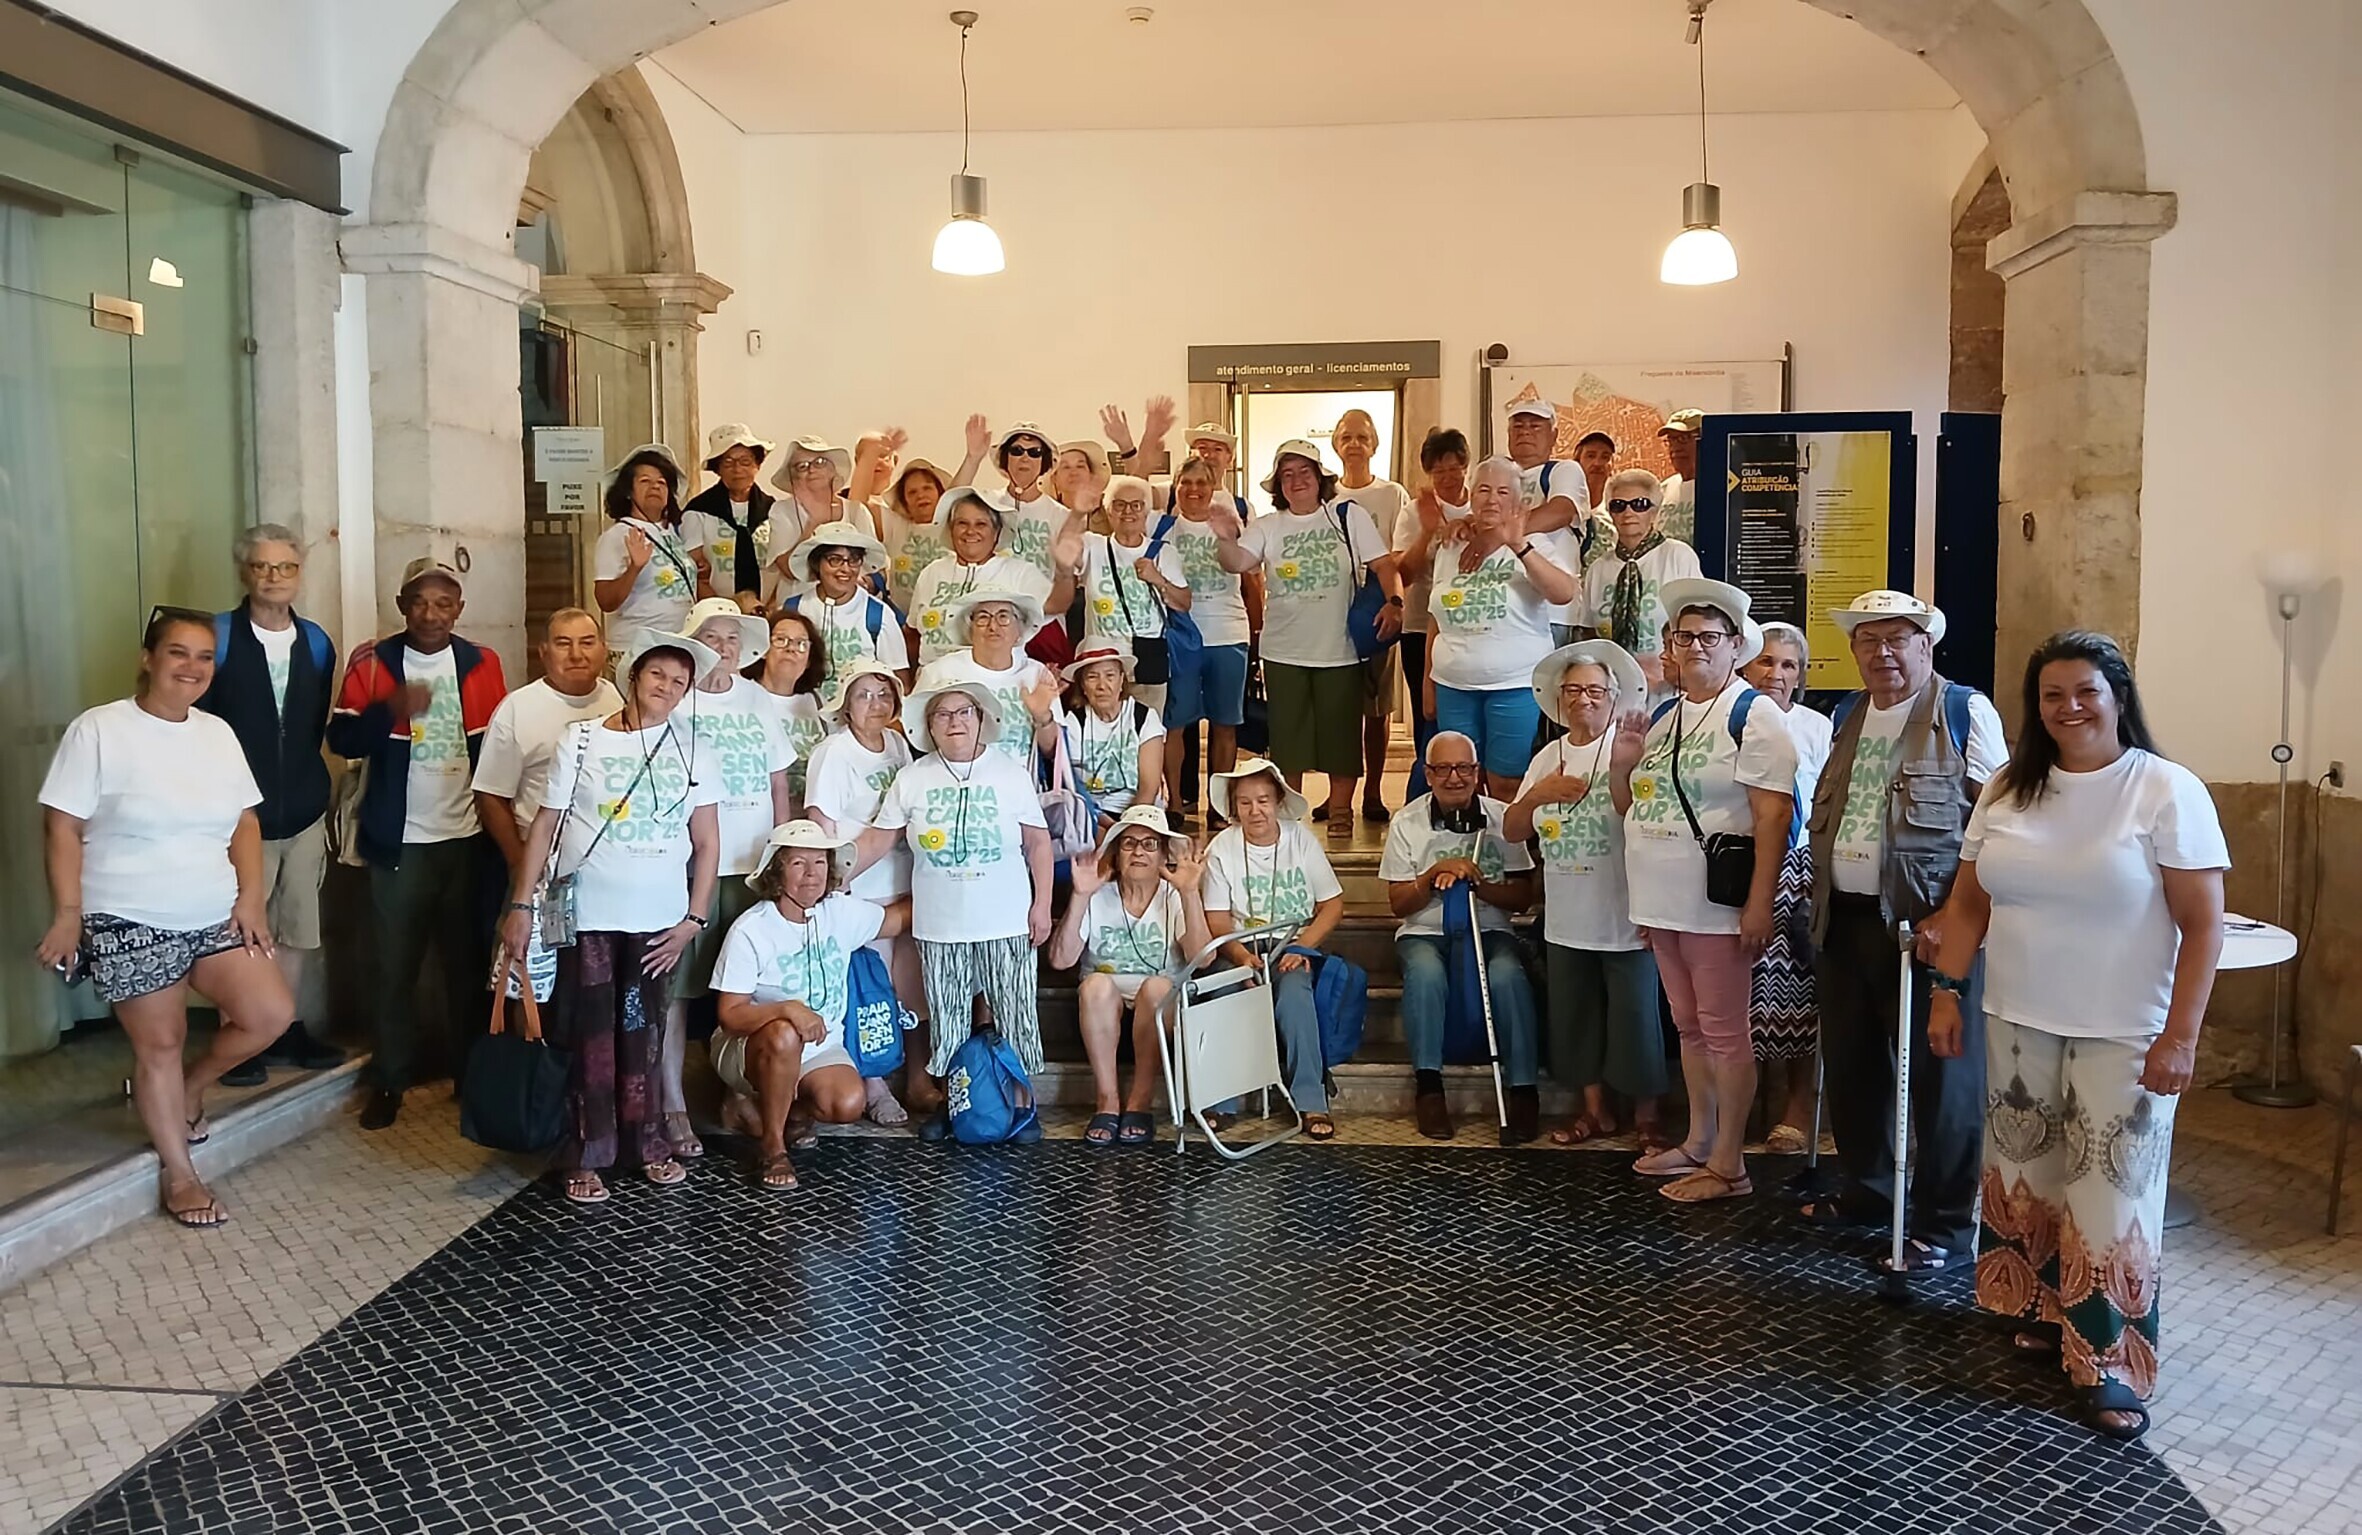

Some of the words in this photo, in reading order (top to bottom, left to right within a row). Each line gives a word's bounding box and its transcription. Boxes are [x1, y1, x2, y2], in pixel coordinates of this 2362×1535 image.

[1286, 363, 1314, 376] geral
[1326, 362, 1411, 374] licenciamentos
[1741, 468, 1762, 477] GUIA
[1282, 527, 1338, 548] PRAIA
[1281, 541, 1338, 559] CAMP
[1297, 556, 1340, 575] SEN
[1480, 558, 1516, 572] AIA
[1450, 572, 1513, 590] CAMP
[1463, 585, 1507, 606] SEN
[1445, 607, 1481, 625] IOR
[687, 712, 764, 733] PRAIA
[722, 752, 768, 774] SEN
[925, 784, 998, 806] PRAIA
[925, 803, 1000, 827] CAMP
[947, 824, 1004, 847] SEN
[1560, 814, 1610, 838] SEN
[1241, 866, 1307, 894] PRAIA
[856, 1000, 891, 1019] PRAIA
[869, 1023, 894, 1040] SEN
